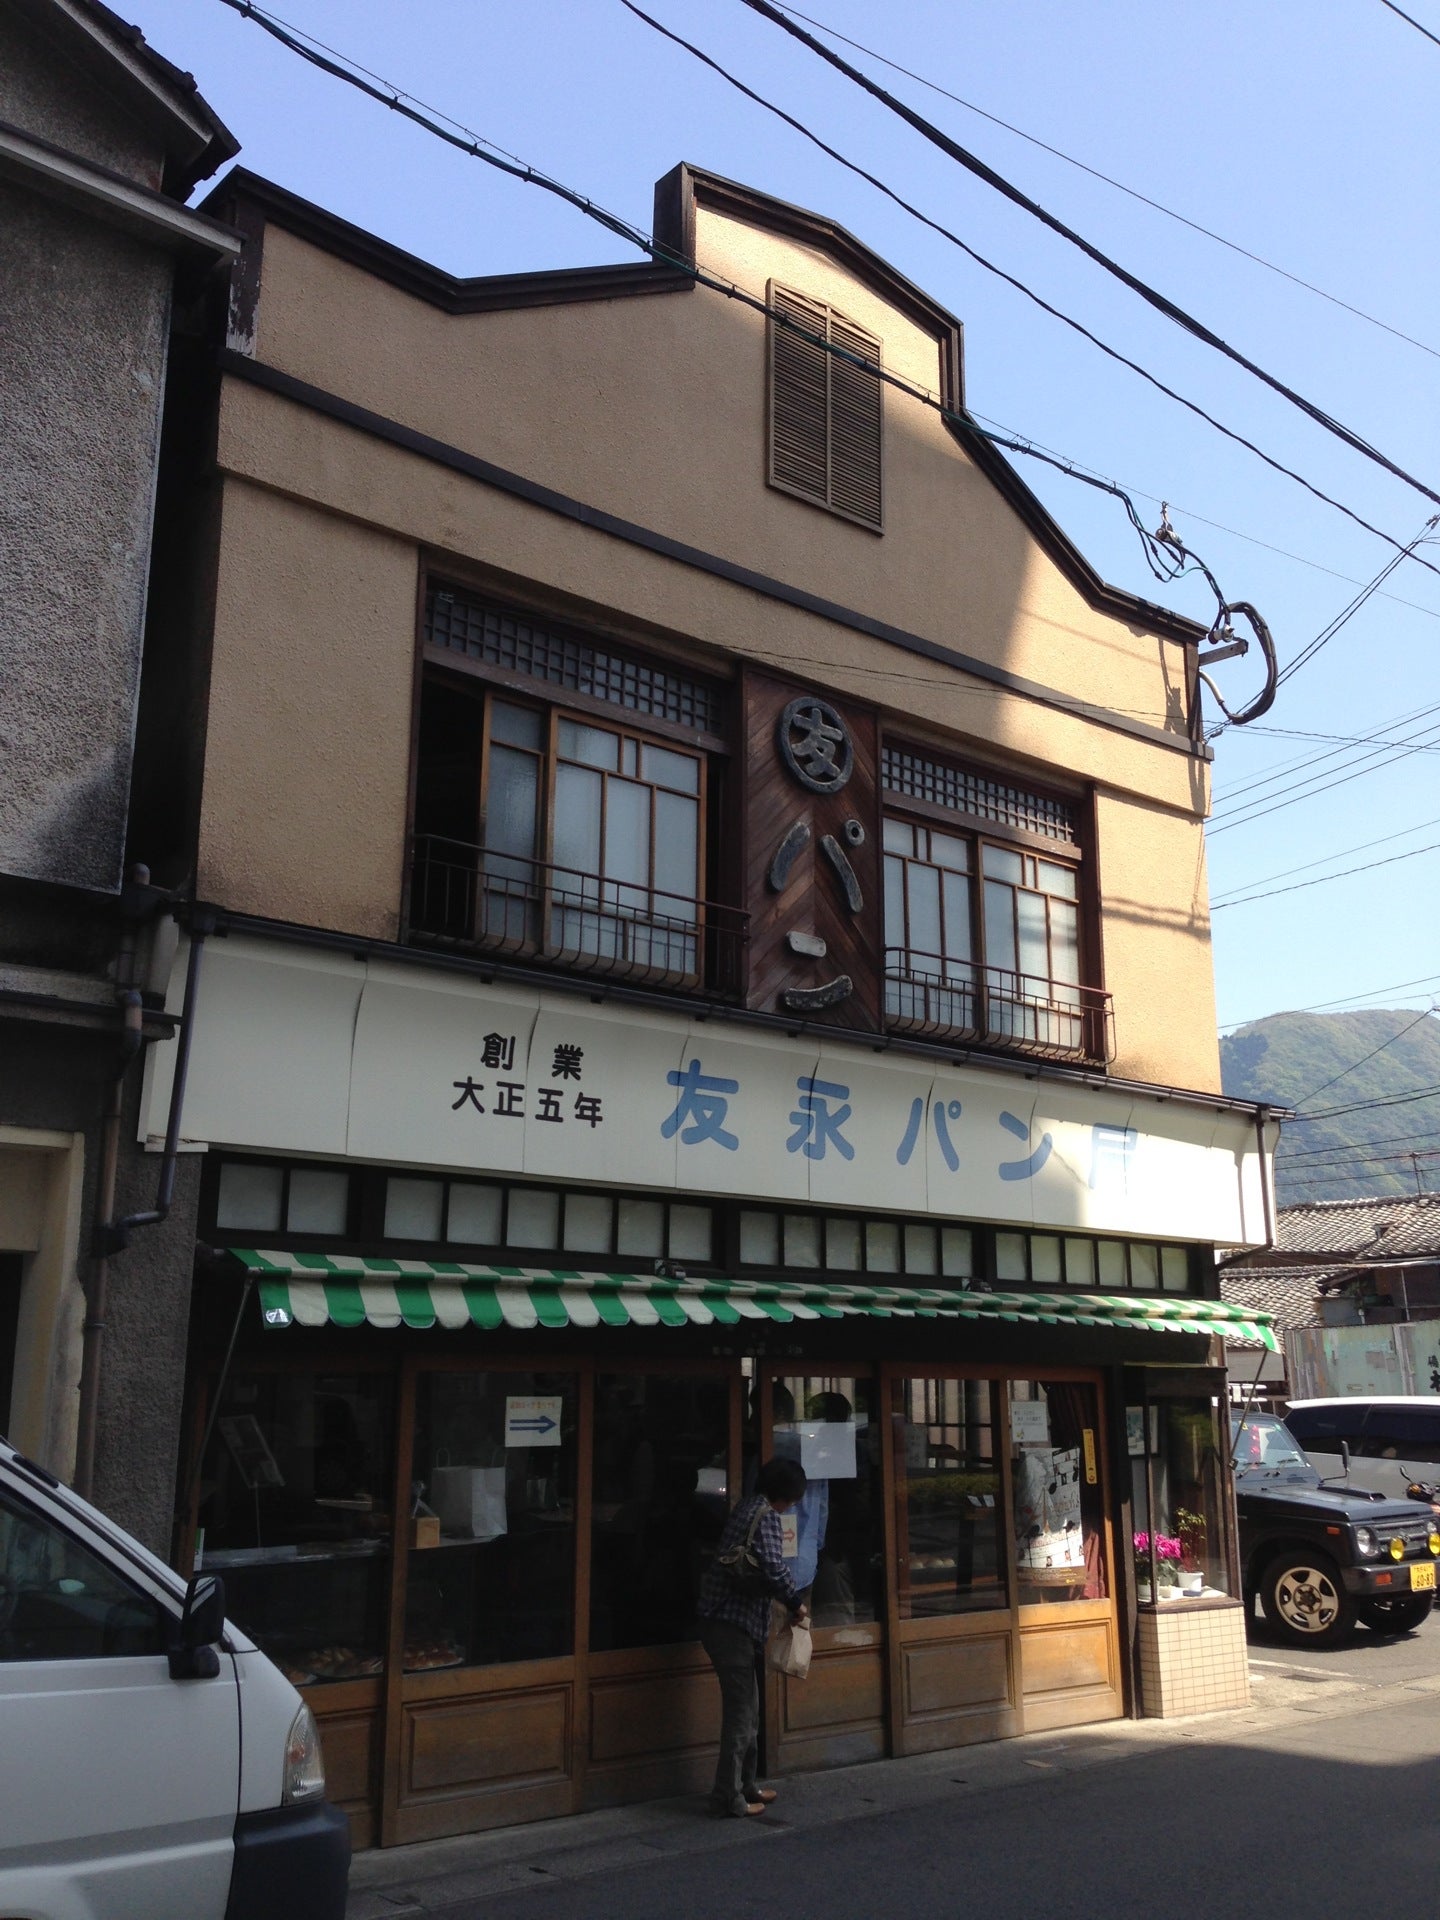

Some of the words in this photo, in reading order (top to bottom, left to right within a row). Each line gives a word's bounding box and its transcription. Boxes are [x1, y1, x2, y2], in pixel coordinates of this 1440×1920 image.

[480, 1032, 584, 1081] 創業
[451, 1076, 603, 1129] 大正五年
